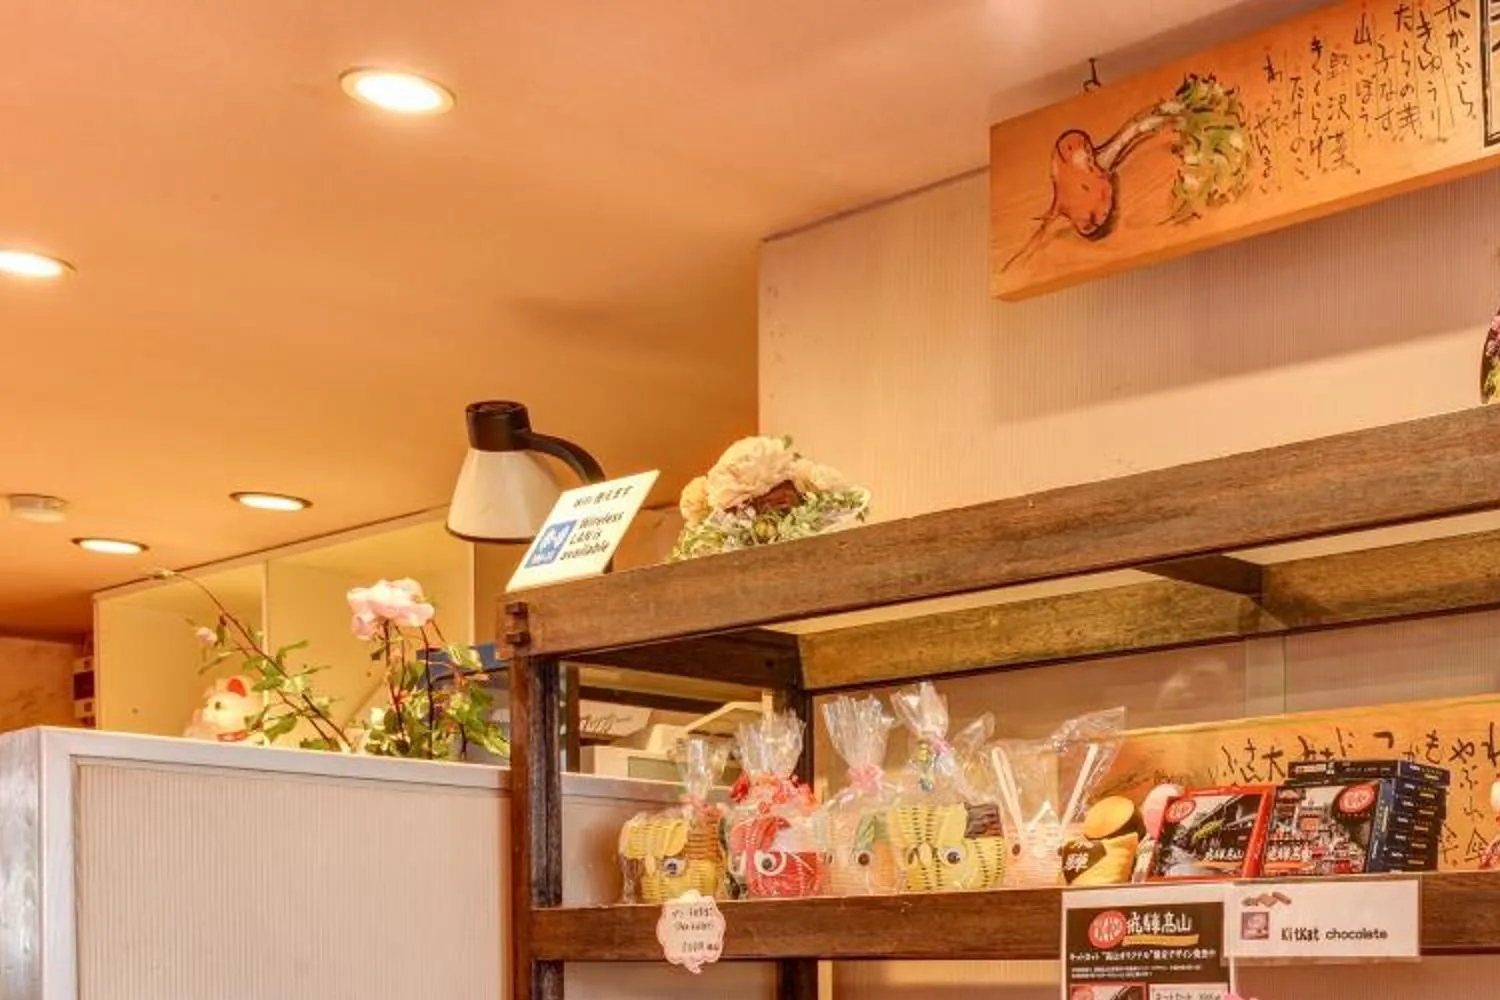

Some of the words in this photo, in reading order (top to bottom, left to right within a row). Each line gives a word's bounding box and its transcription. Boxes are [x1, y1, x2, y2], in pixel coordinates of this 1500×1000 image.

[1127, 911, 1193, 934] 飛騨高山
[1280, 927, 1320, 942] KitKat
[1325, 927, 1389, 941] chocolate
